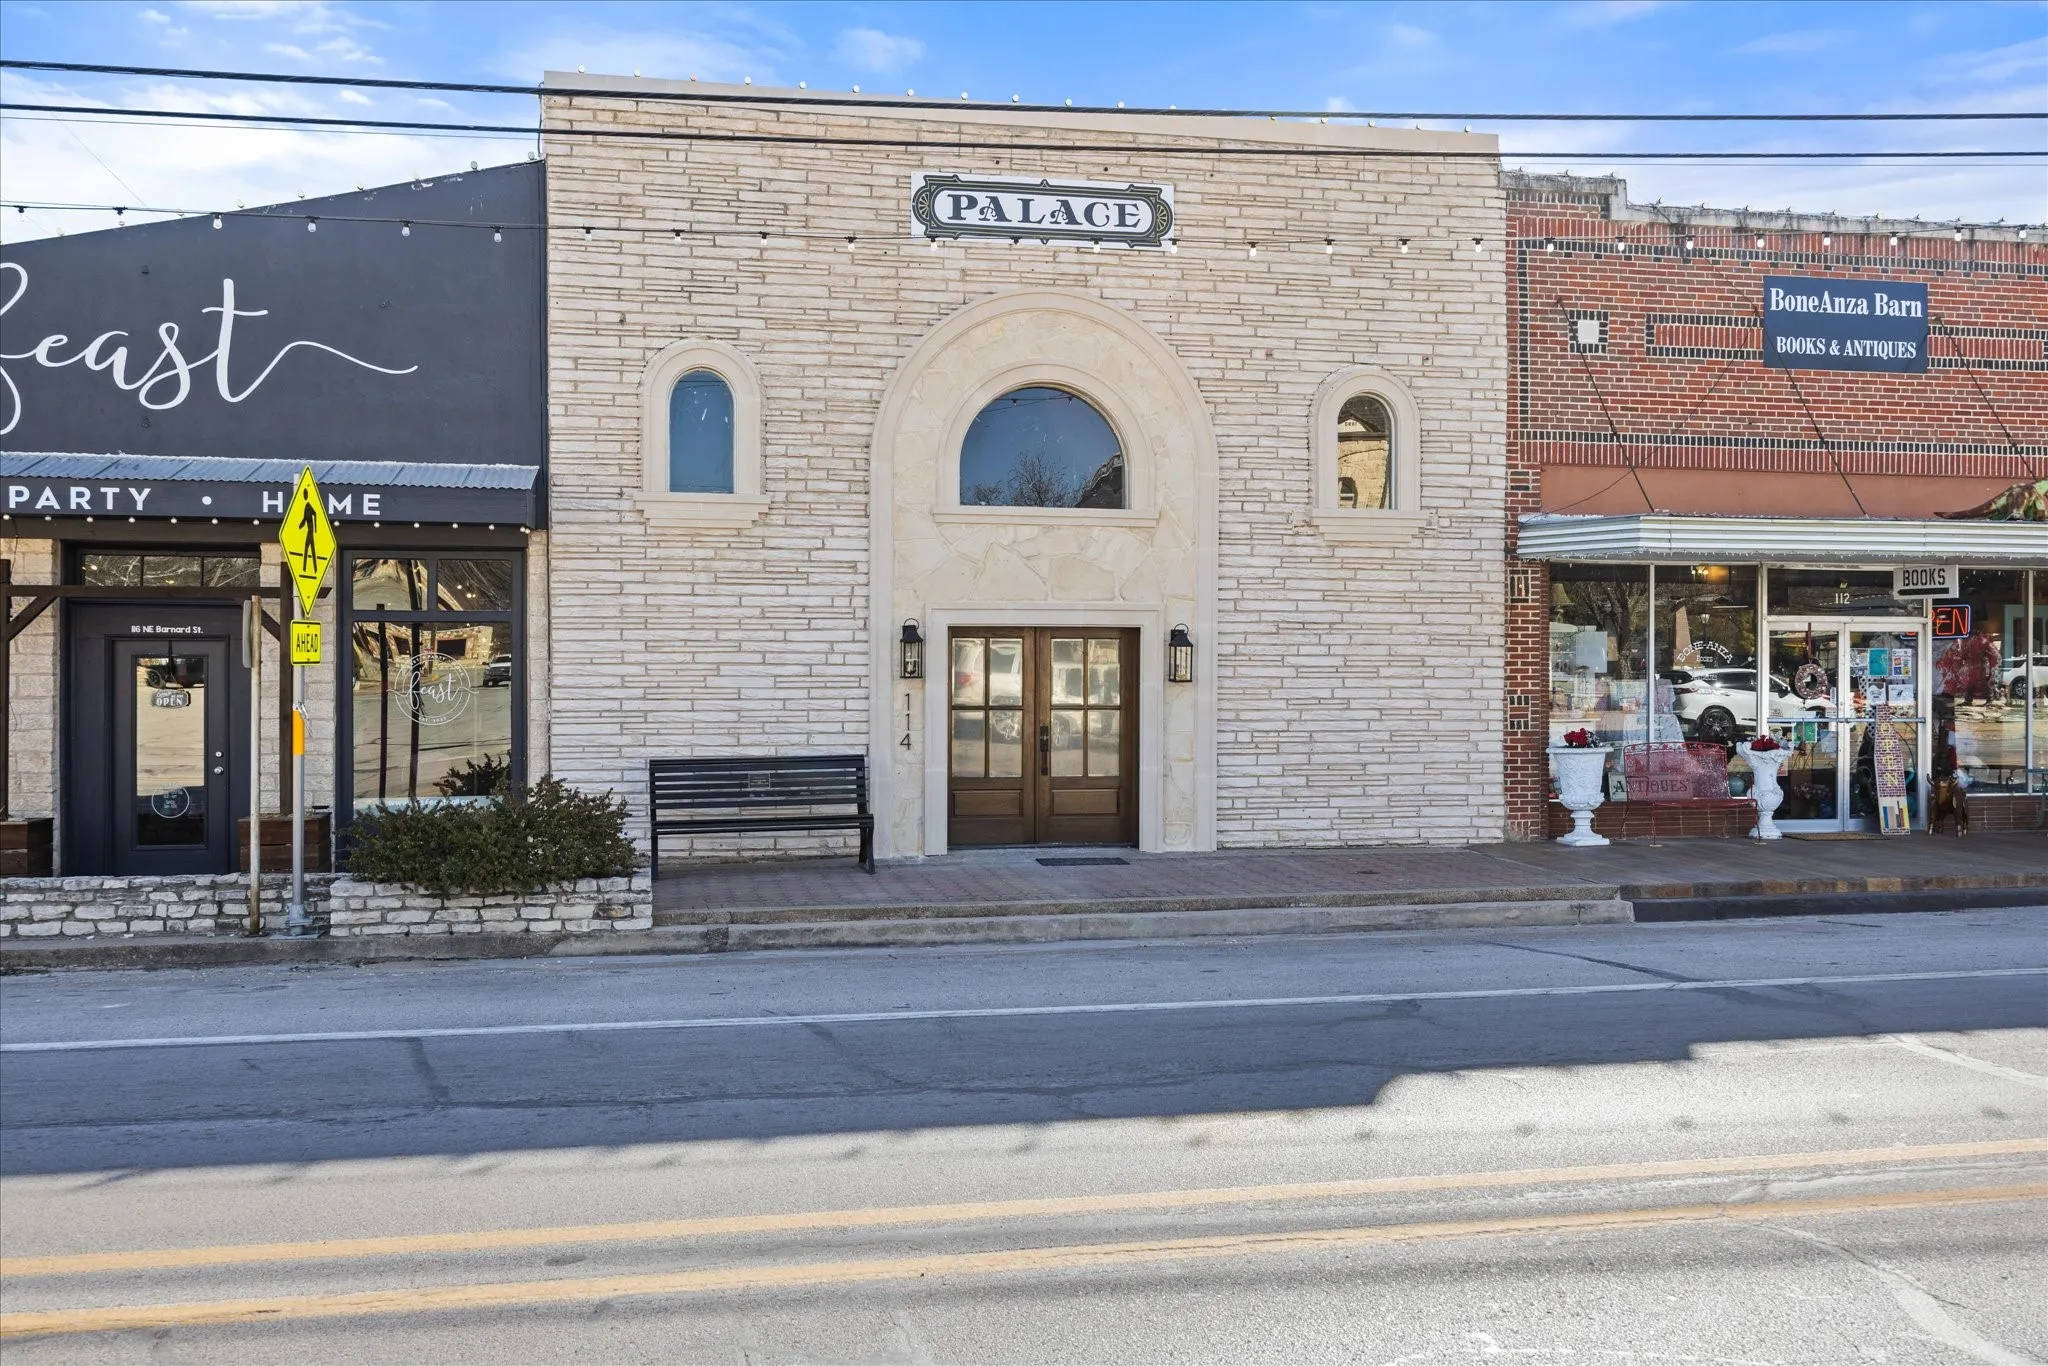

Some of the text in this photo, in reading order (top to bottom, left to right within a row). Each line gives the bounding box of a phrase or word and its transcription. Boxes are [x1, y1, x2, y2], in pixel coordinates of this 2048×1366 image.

[946, 193, 1142, 228] PALACE
[1769, 287, 1923, 318] BoneAnza Barn
[1776, 336, 1917, 360] BOOKS & ANTIQUES
[8, 485, 381, 515] PARTY HME
[1902, 568, 1946, 587] BOOKS
[1834, 592, 1851, 605] 112
[131, 625, 204, 634] 116 NE Barnard St.
[295, 632, 319, 653] AHEAD
[1676, 640, 1734, 664] BONE-ANZA
[156, 698, 183, 706] OPEN
[386, 671, 480, 710] feast
[899, 692, 912, 751] 114
[1880, 722, 1899, 787] OPEN
[1614, 779, 1688, 794] ANTIQUES
